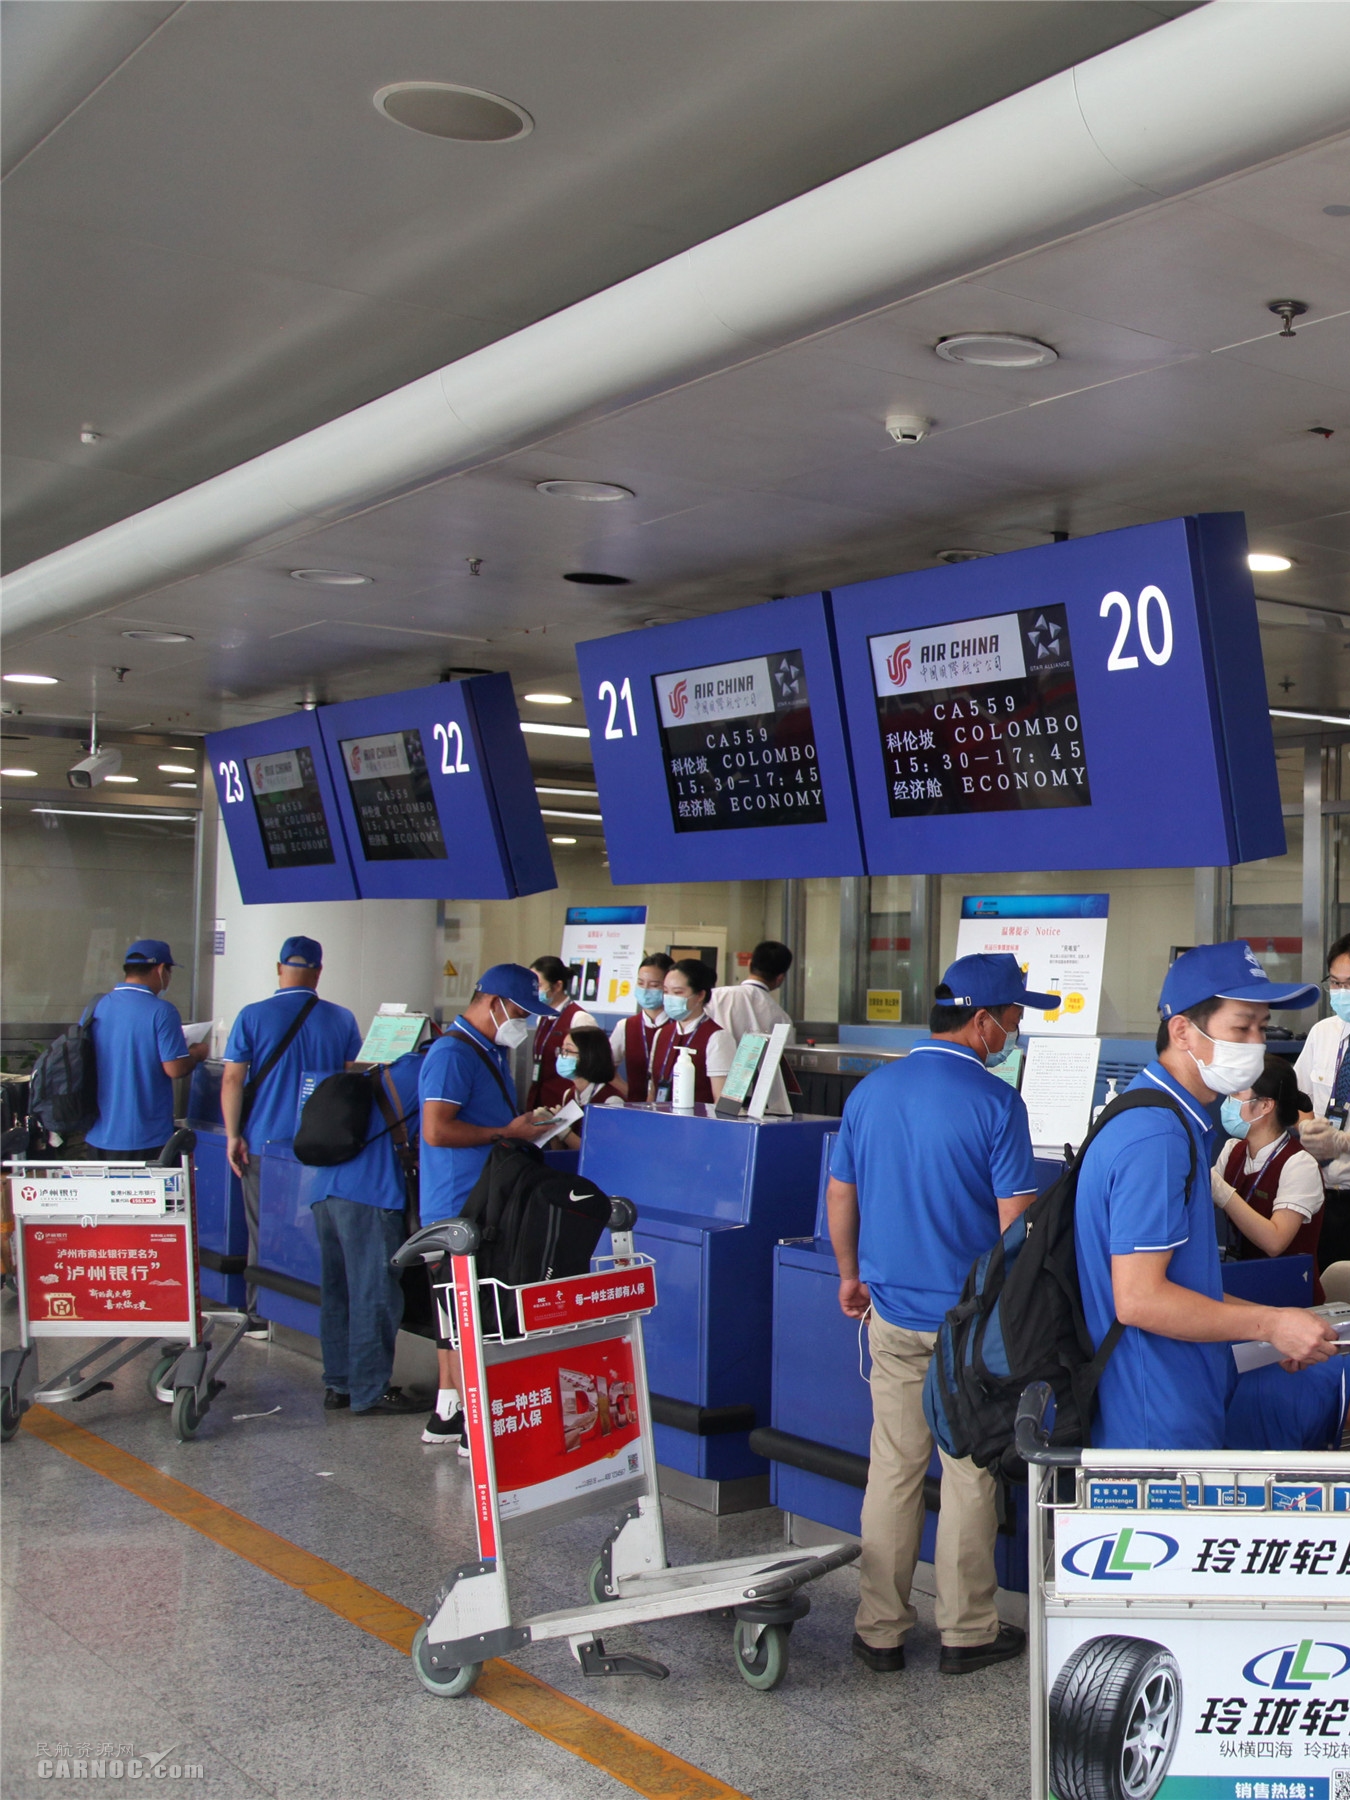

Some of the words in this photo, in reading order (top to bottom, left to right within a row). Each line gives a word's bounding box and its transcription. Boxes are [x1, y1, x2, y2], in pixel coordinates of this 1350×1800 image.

[1099, 584, 1174, 671] 20
[920, 641, 947, 664] AIR
[950, 634, 999, 659] CHINA
[1029, 664, 1044, 672] STAR
[1044, 660, 1071, 670] ALLIANCE
[694, 682, 714, 699] AIR
[717, 674, 754, 697] CHINA
[598, 677, 638, 740] 21
[934, 695, 1016, 721] CA559
[433, 721, 471, 774] 22
[706, 727, 768, 749] CA559
[886, 729, 936, 753] 科伦坡
[954, 714, 1078, 743] COLOMBO
[671, 755, 710, 777] 科伦坡
[722, 744, 816, 769] COLOMBO
[219, 760, 245, 803] 23
[893, 779, 943, 800] 经济舱
[963, 767, 1086, 794] ECONOMY
[386, 801, 433, 815] COLOMBO
[678, 798, 717, 818] 经济舱
[730, 789, 822, 812] ECONOMY
[393, 830, 440, 844] ECONOMY
[1036, 926, 1061, 936] Notice
[57, 1249, 158, 1259] 泸州市商业银行更名为
[575, 1282, 645, 1306] 每一种生活都有人保
[491, 1387, 552, 1417] 每一种生活
[492, 1408, 542, 1437] 都有人保
[1220, 1741, 1293, 1759] 纵横四海
